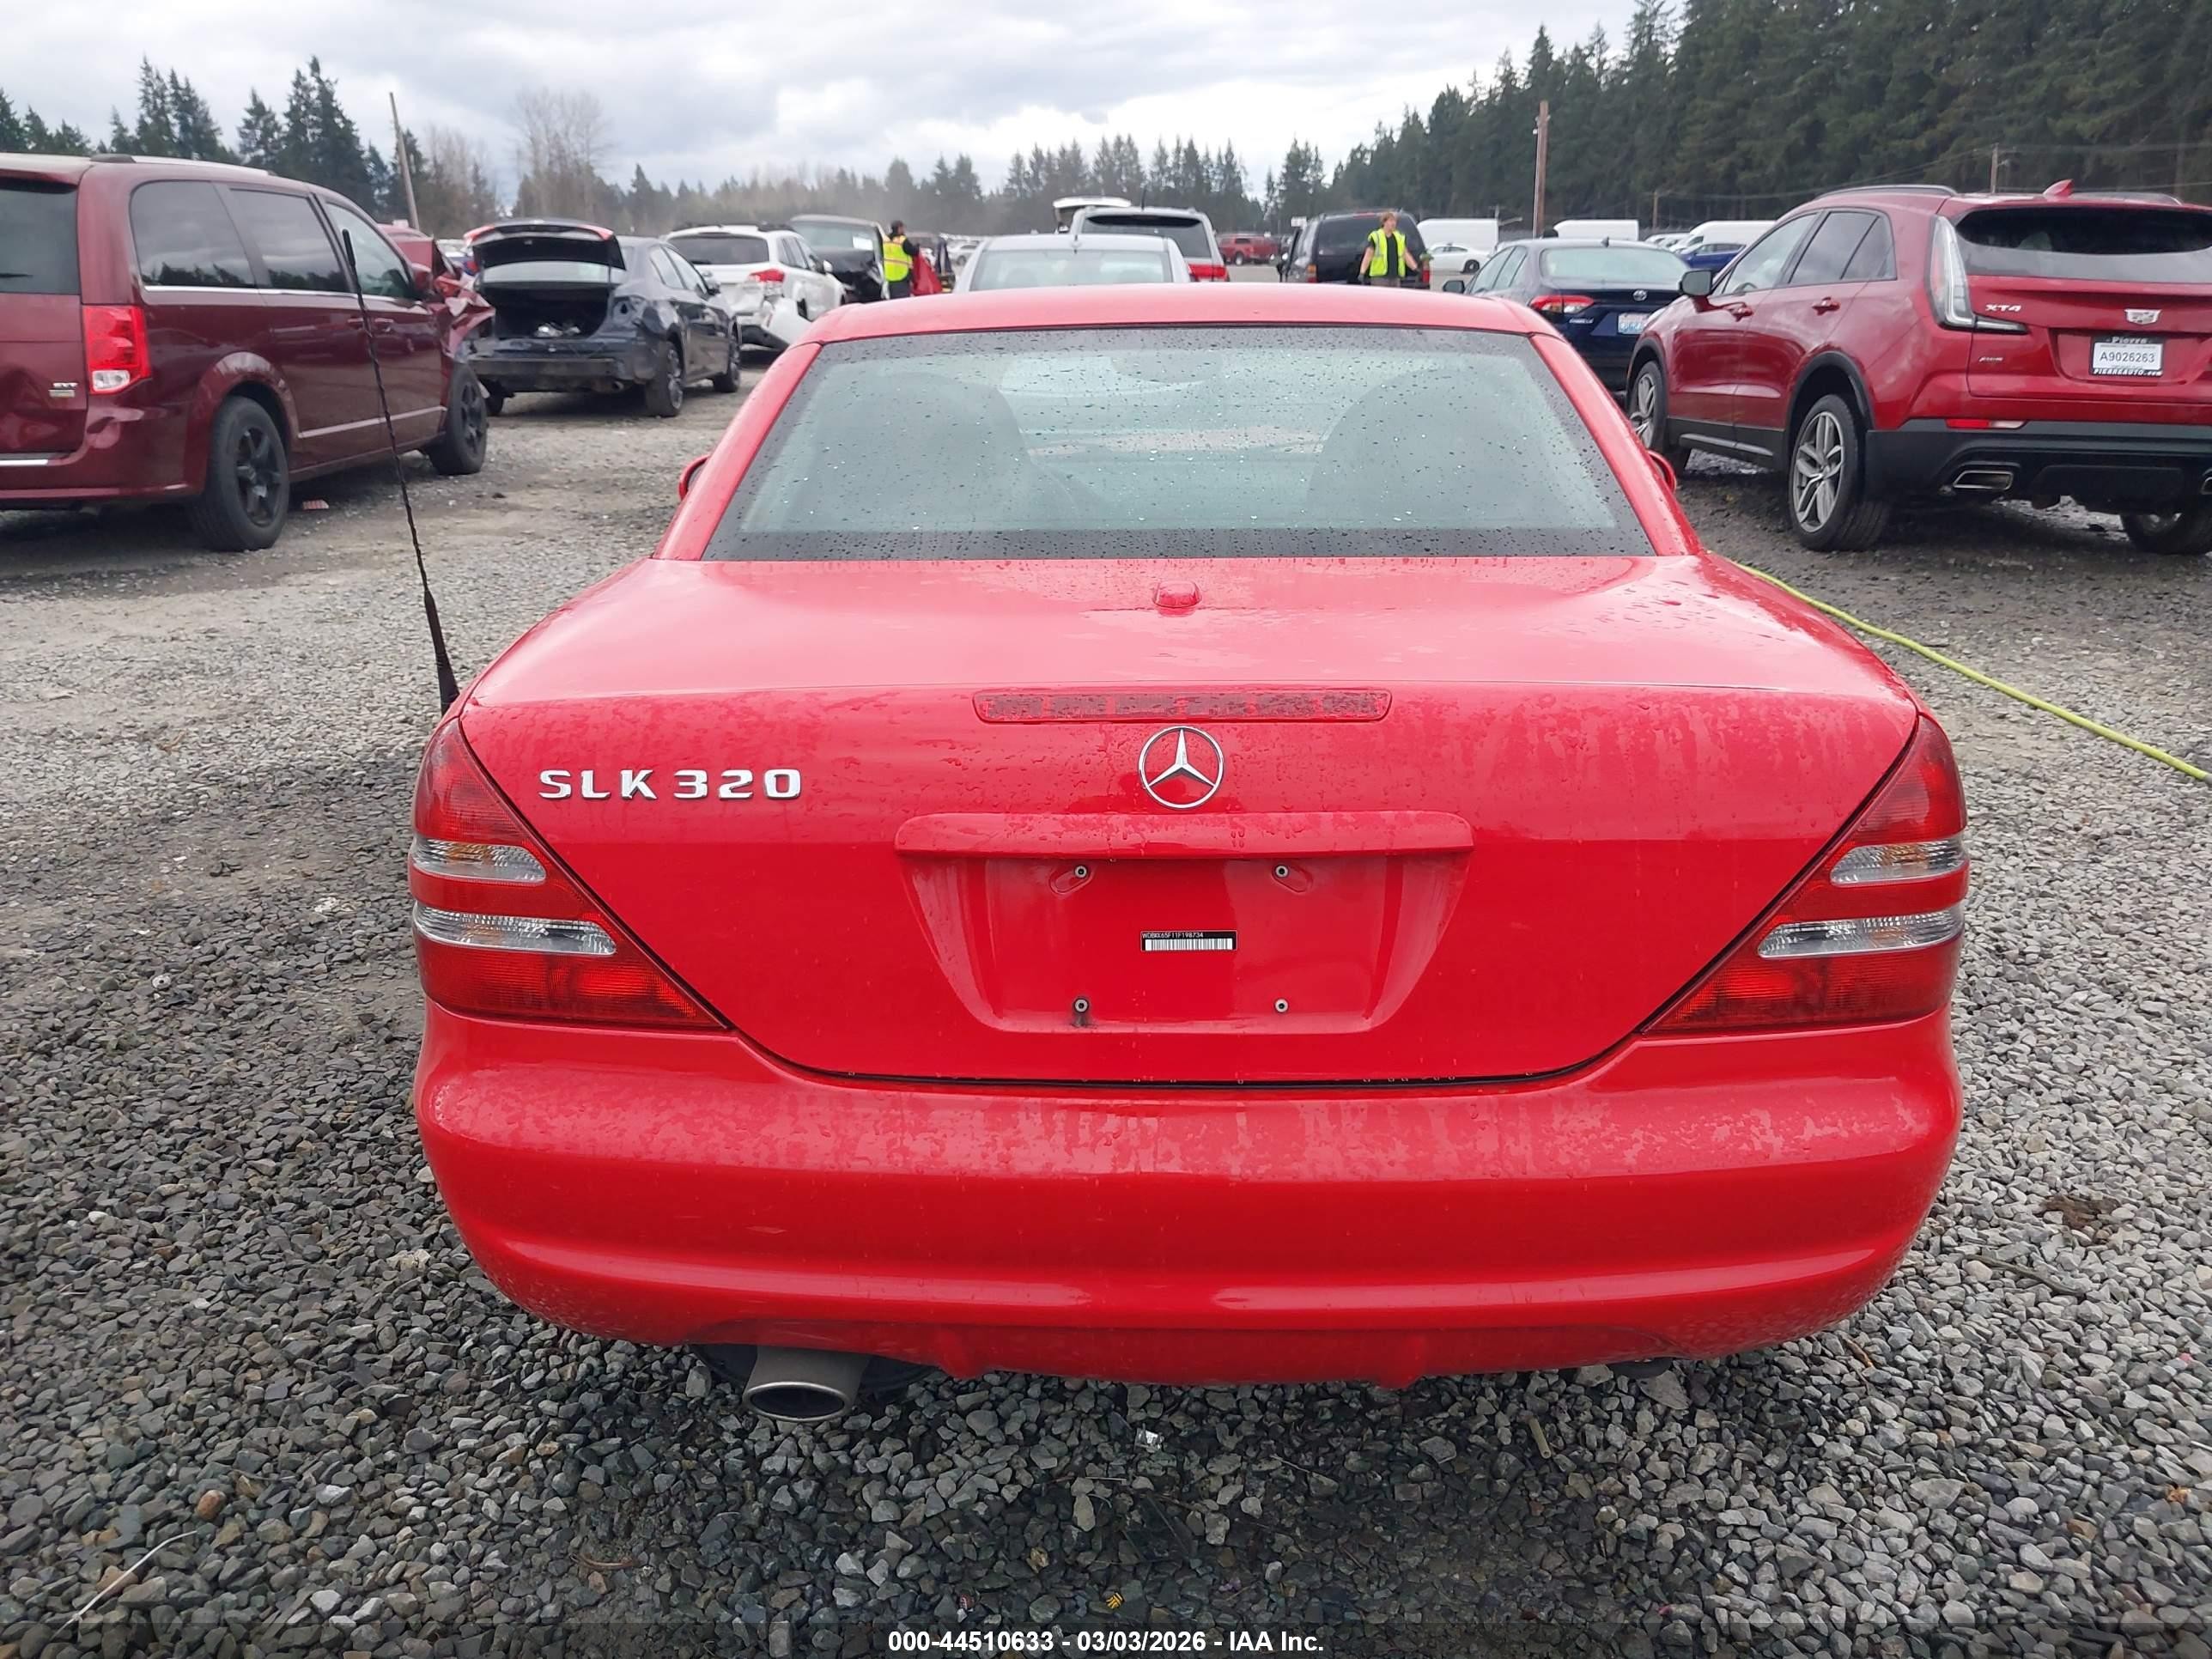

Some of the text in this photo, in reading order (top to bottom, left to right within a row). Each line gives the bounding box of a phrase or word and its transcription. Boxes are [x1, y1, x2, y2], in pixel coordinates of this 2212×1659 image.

[2111, 336, 2148, 344] Pierre
[2100, 351, 2155, 363] A9026263
[538, 769, 802, 799] SLK 320
